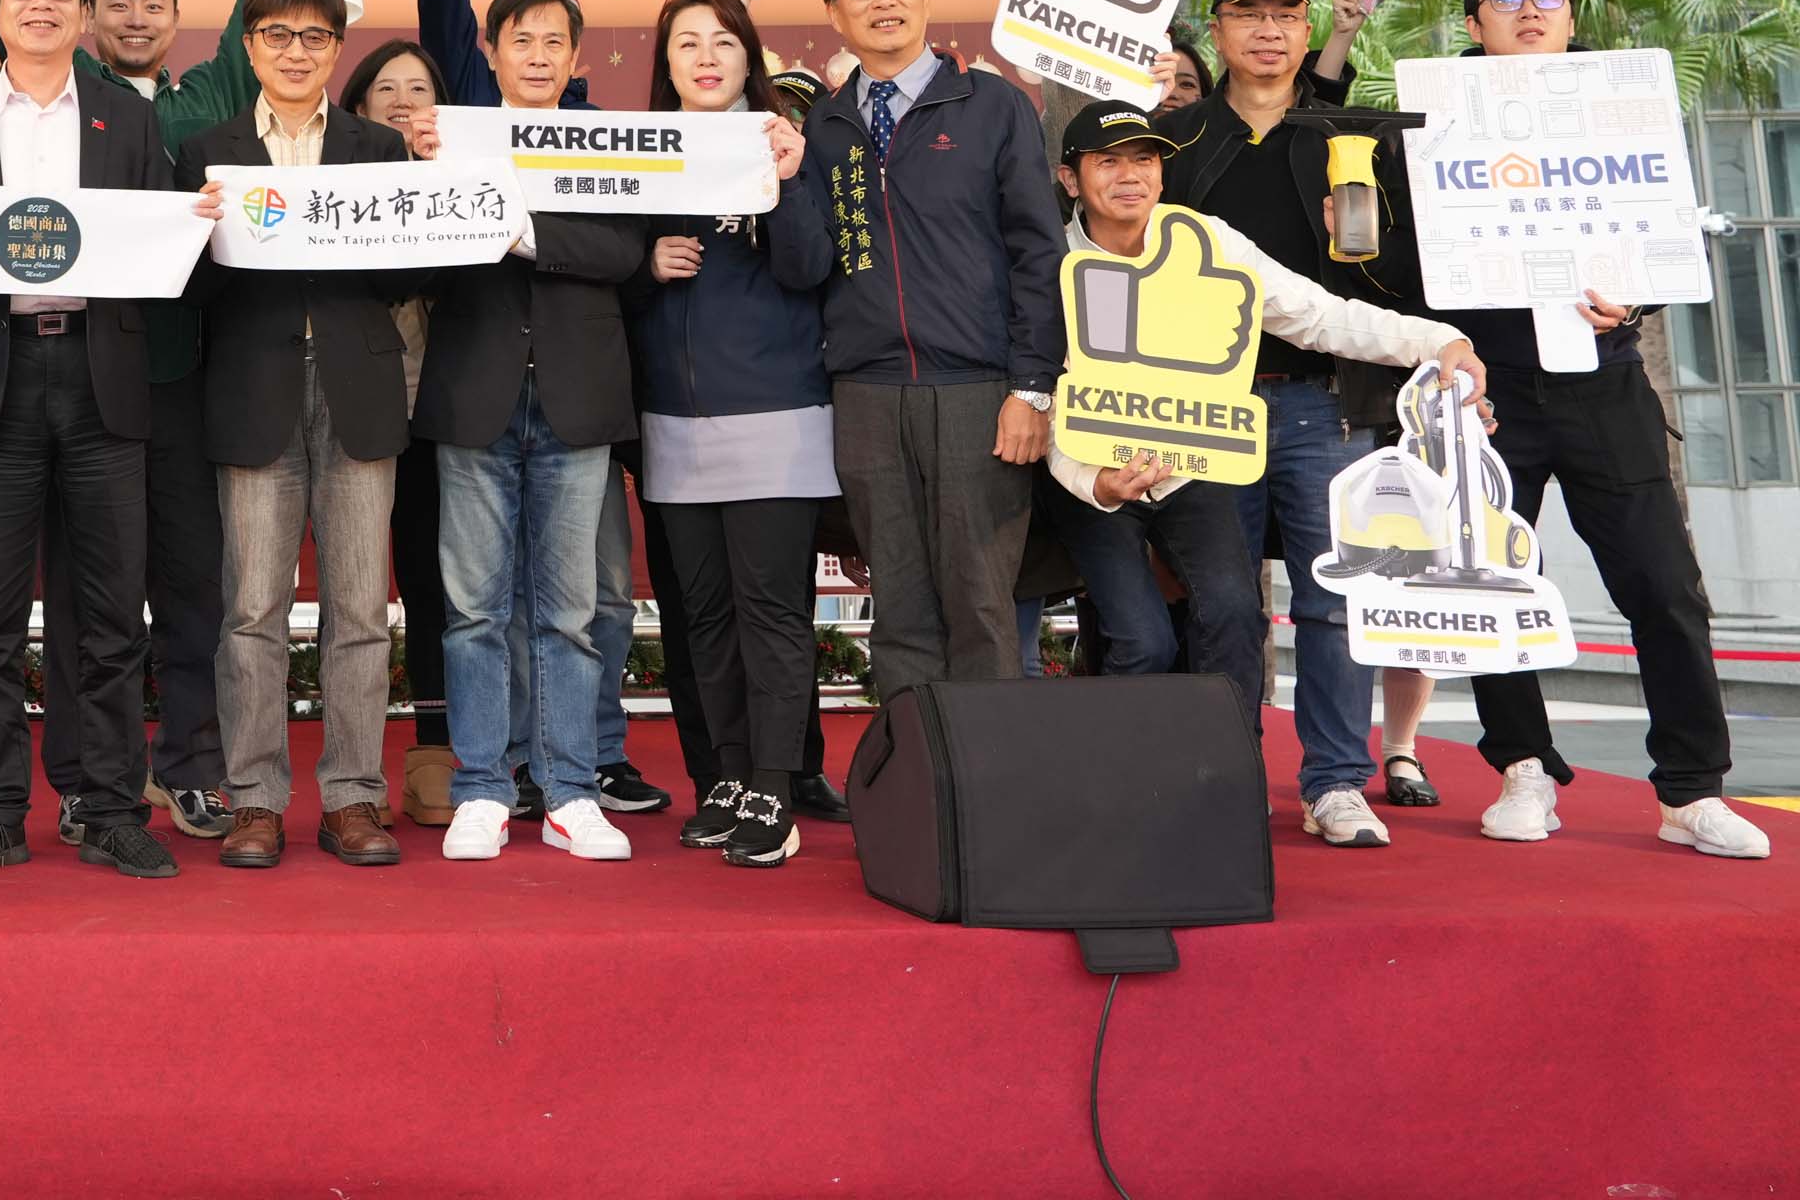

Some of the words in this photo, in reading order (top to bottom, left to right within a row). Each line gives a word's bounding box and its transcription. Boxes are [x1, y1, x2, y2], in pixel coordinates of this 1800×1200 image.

[1034, 52, 1113, 97] 德國凱馳
[511, 125, 684, 152] KÄRCHER
[553, 176, 640, 196] 德國凱馳
[26, 204, 50, 213] 2023
[301, 182, 506, 230] 新北市政府
[848, 145, 873, 271] 新北市板橋區
[1509, 196, 1603, 213] 嘉儀家品
[8, 215, 67, 231] 德國商品
[1469, 220, 1651, 238] 在家是一種享受
[308, 235, 337, 245] New
[343, 234, 386, 247] Taipei
[392, 233, 420, 244] City
[426, 229, 511, 242] Government
[7, 243, 67, 260] 聖誕市集
[1066, 384, 1257, 433] KÄRCHER
[1111, 443, 1208, 475] 德國凱馳
[1362, 608, 1499, 633] KÄRCHER
[1398, 648, 1467, 665] 德國凱馳
